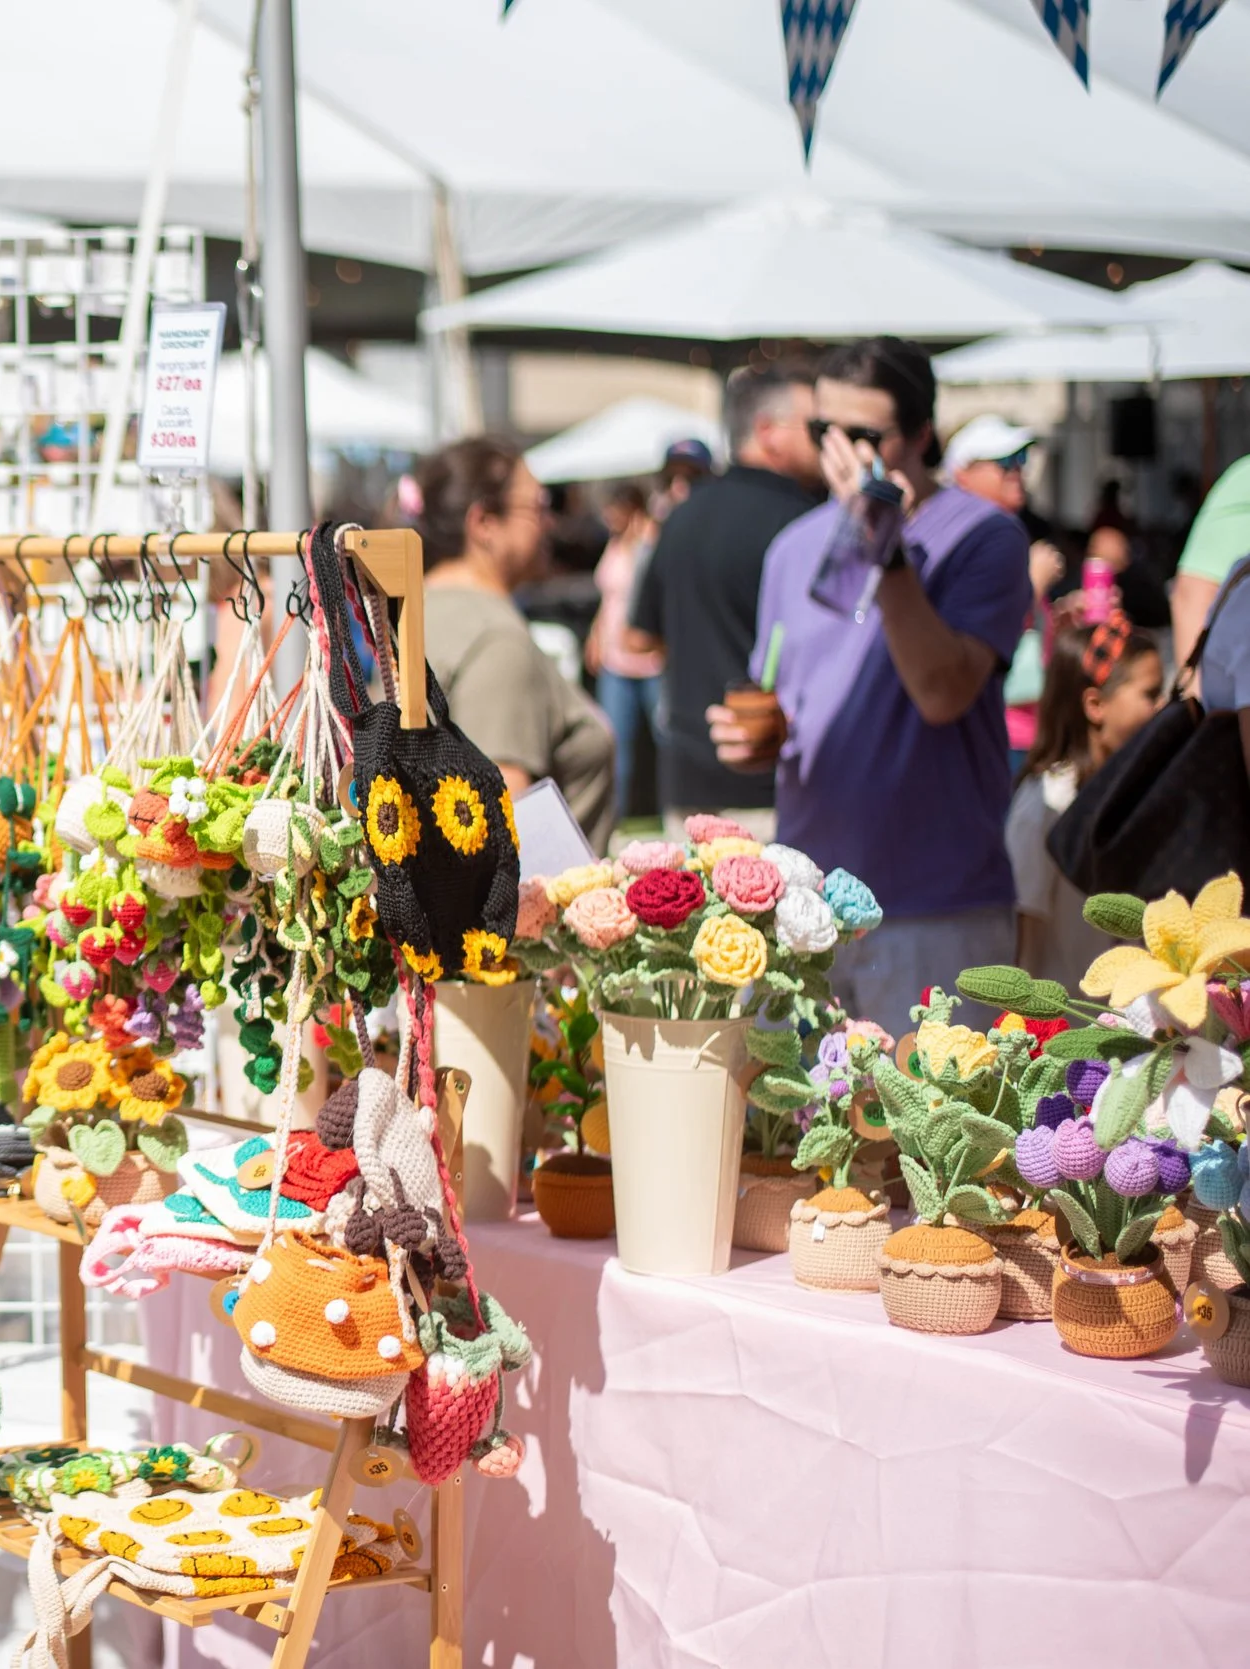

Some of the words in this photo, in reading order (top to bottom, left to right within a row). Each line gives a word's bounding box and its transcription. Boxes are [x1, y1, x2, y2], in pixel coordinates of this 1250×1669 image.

[158, 328, 211, 338] HANDMADE
[160, 340, 205, 350] CROCHET
[156, 375, 202, 391] $27/ea
[151, 432, 197, 448] $30/ea
[369, 1462, 388, 1475] $35
